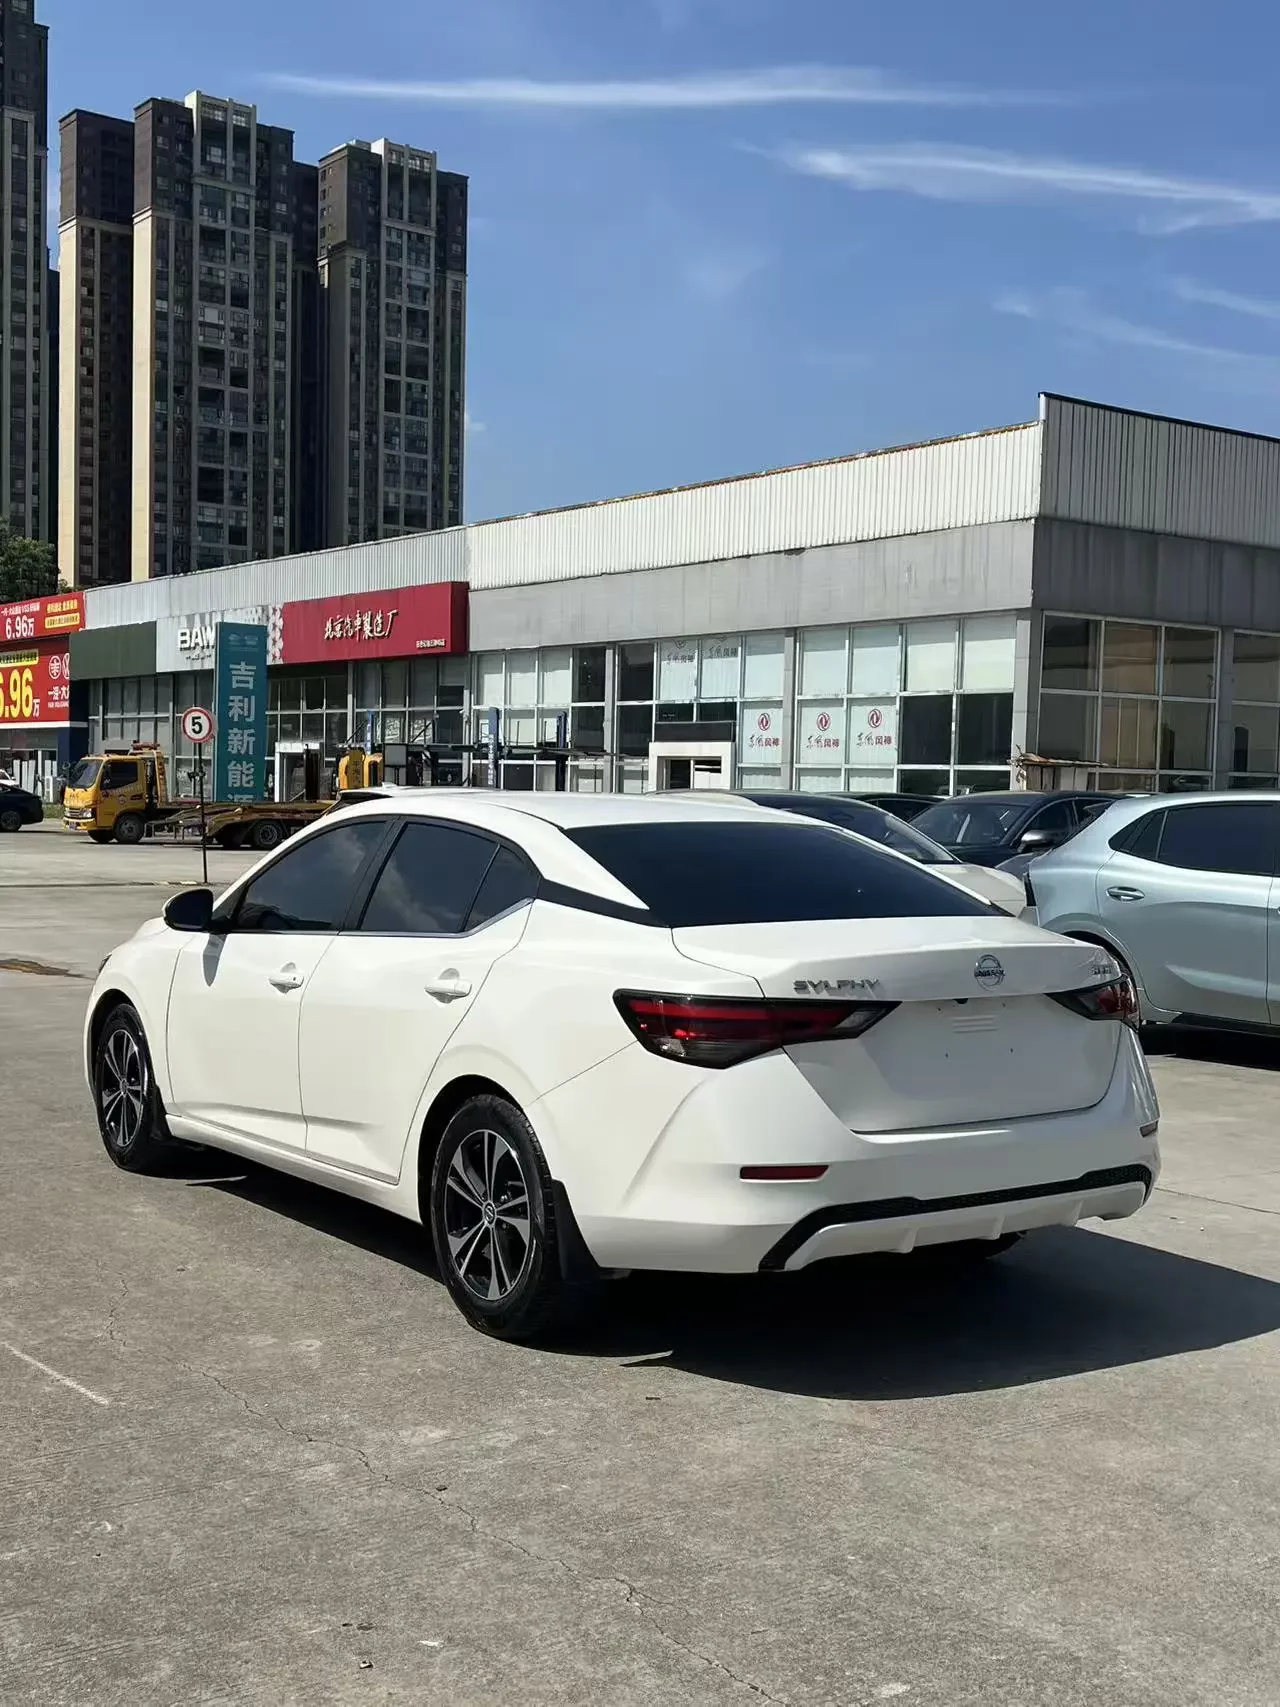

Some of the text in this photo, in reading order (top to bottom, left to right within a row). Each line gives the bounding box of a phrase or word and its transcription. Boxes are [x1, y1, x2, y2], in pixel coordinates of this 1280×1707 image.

[5, 615, 35, 639] 6.96万
[191, 716, 203, 734] 5
[793, 978, 880, 992] SYLPHY
